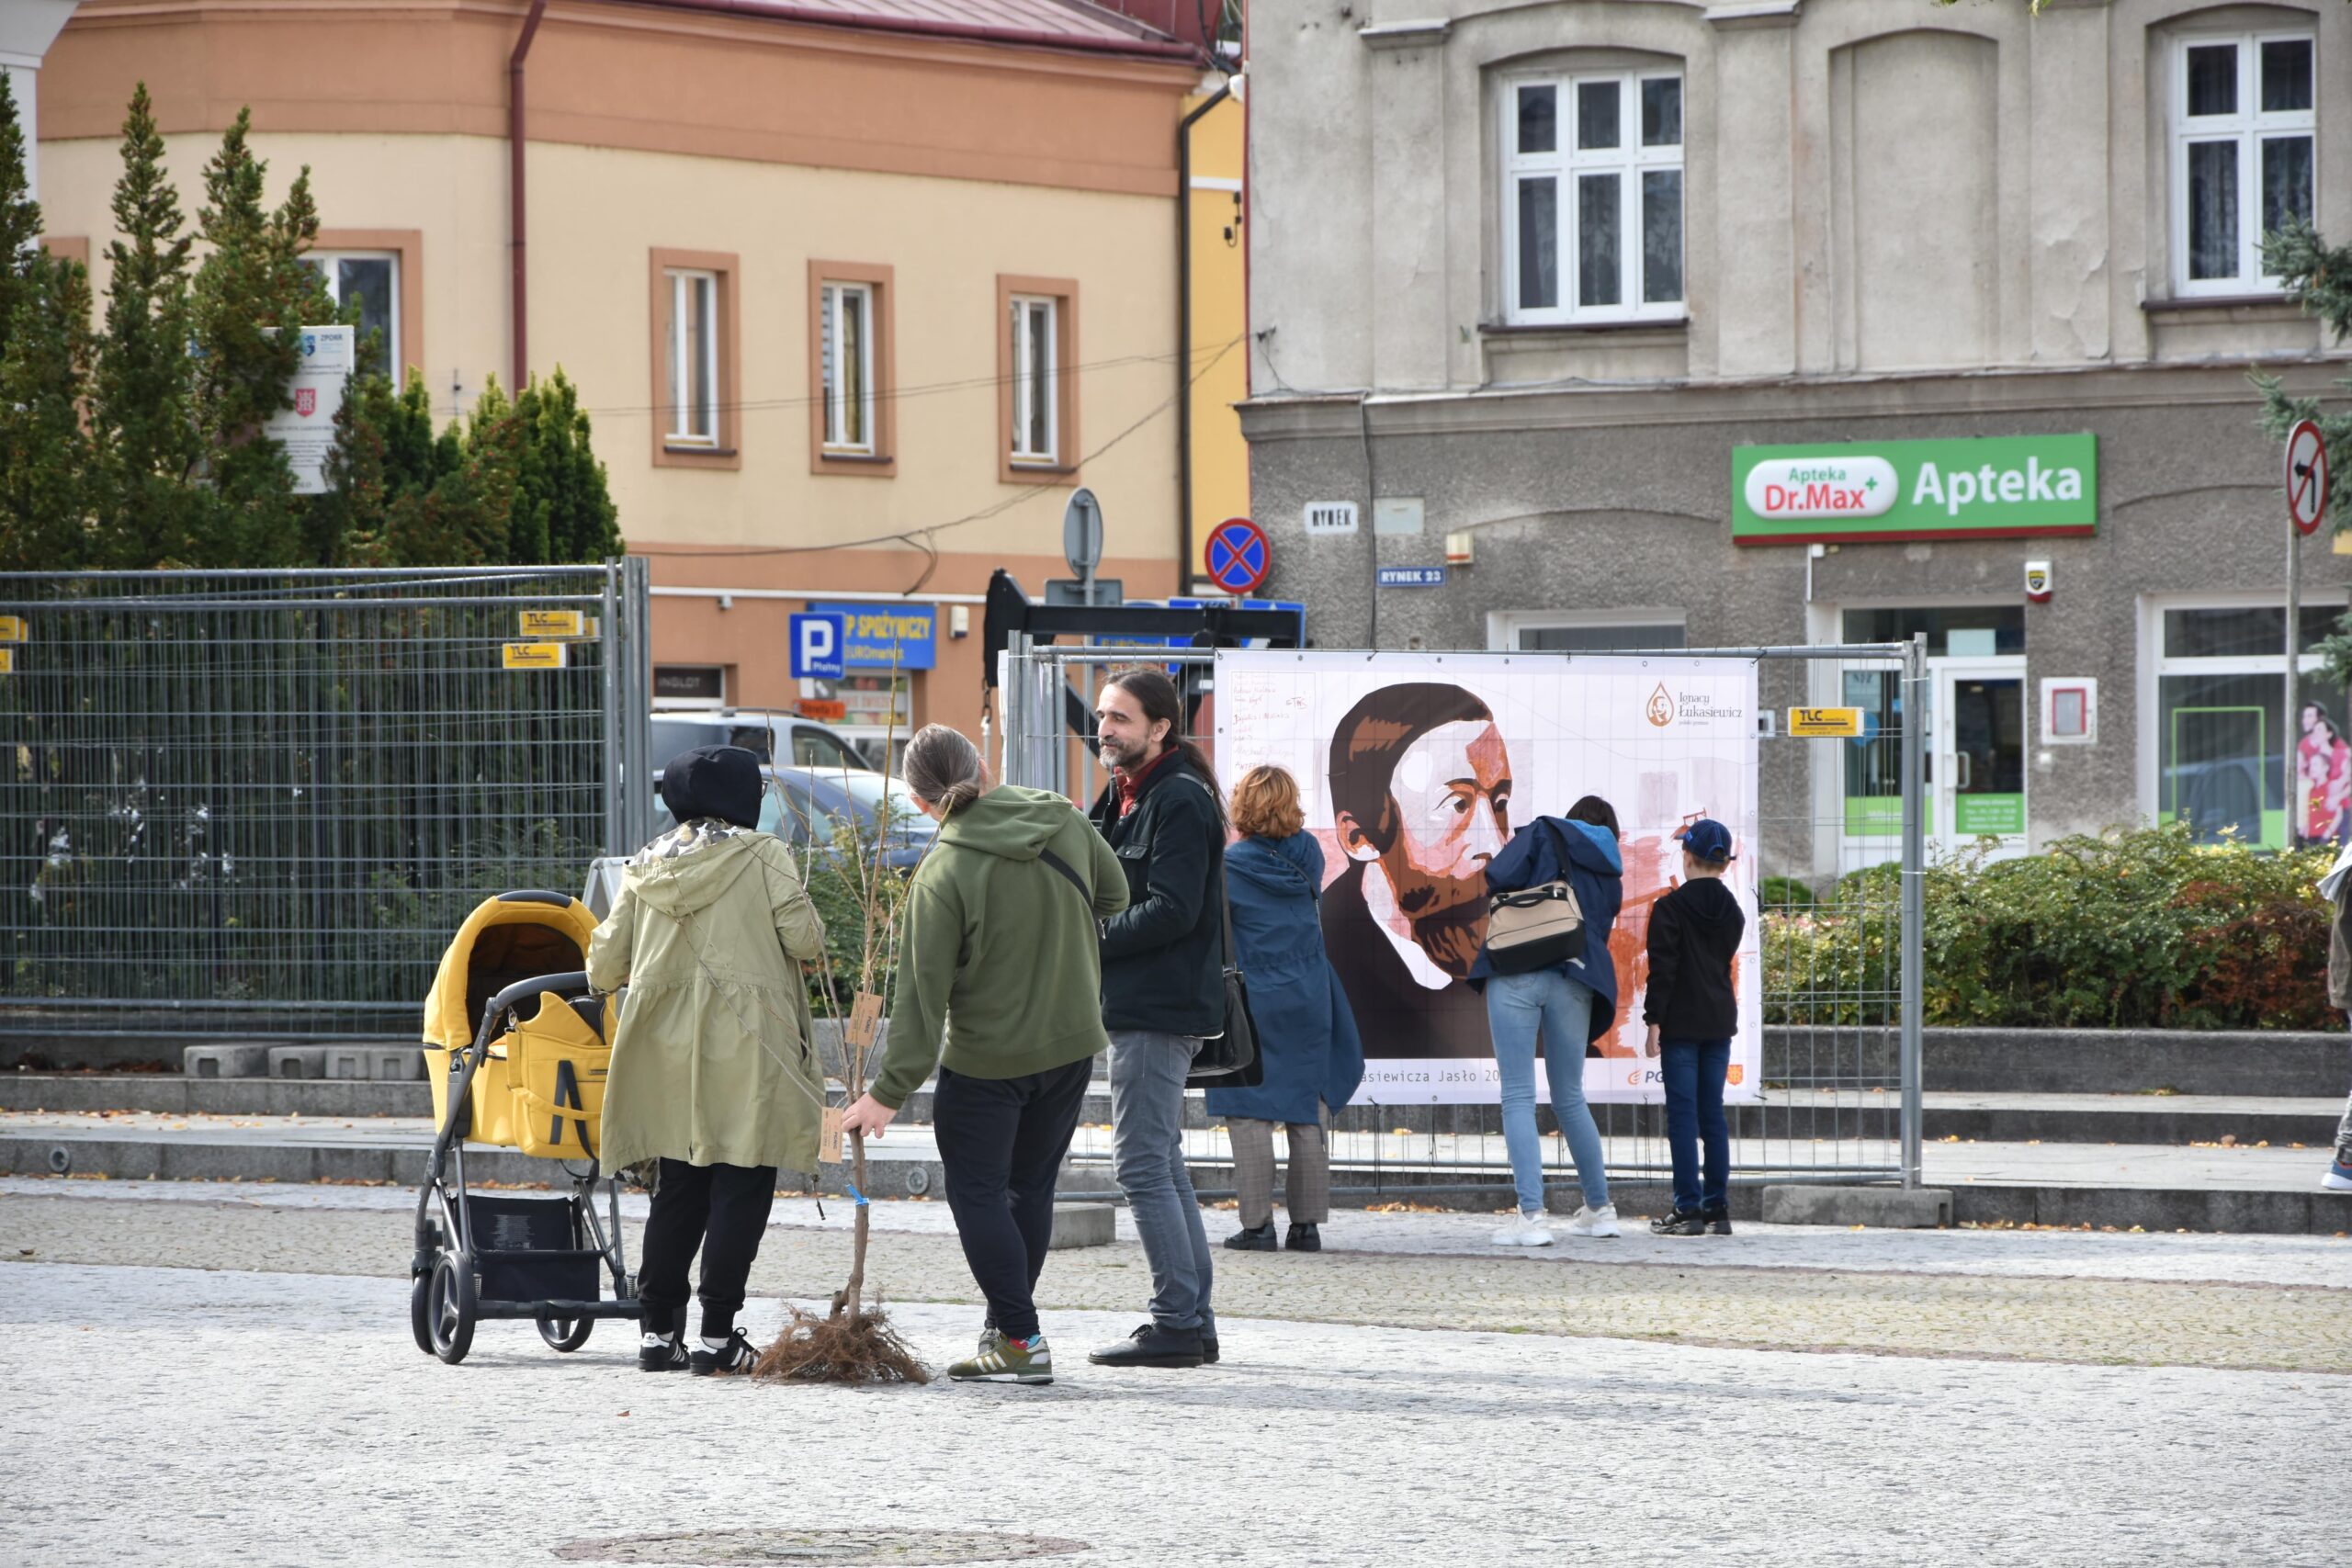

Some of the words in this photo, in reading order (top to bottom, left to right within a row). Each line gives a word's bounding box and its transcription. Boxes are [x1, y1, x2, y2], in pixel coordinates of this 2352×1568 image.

[1788, 466, 1847, 483] Apteka
[1912, 456, 2082, 516] Apteka
[1764, 483, 1865, 513] Dr.Max
[1312, 508, 1351, 527] RYNEK
[1381, 570, 1422, 582] RYNEK
[1425, 570, 1442, 582] 23
[527, 613, 548, 623] TLC
[511, 645, 530, 655] TLC
[801, 619, 833, 672] P
[1679, 691, 1710, 706] Ignacy
[1678, 705, 1743, 718] Łukasiewicz
[1799, 709, 1823, 722] TLC
[1362, 1070, 1430, 1083] asiewicza
[1438, 1070, 1477, 1083] Jasło
[1485, 1069, 1500, 1082] 20
[1645, 1070, 1665, 1083] PG
